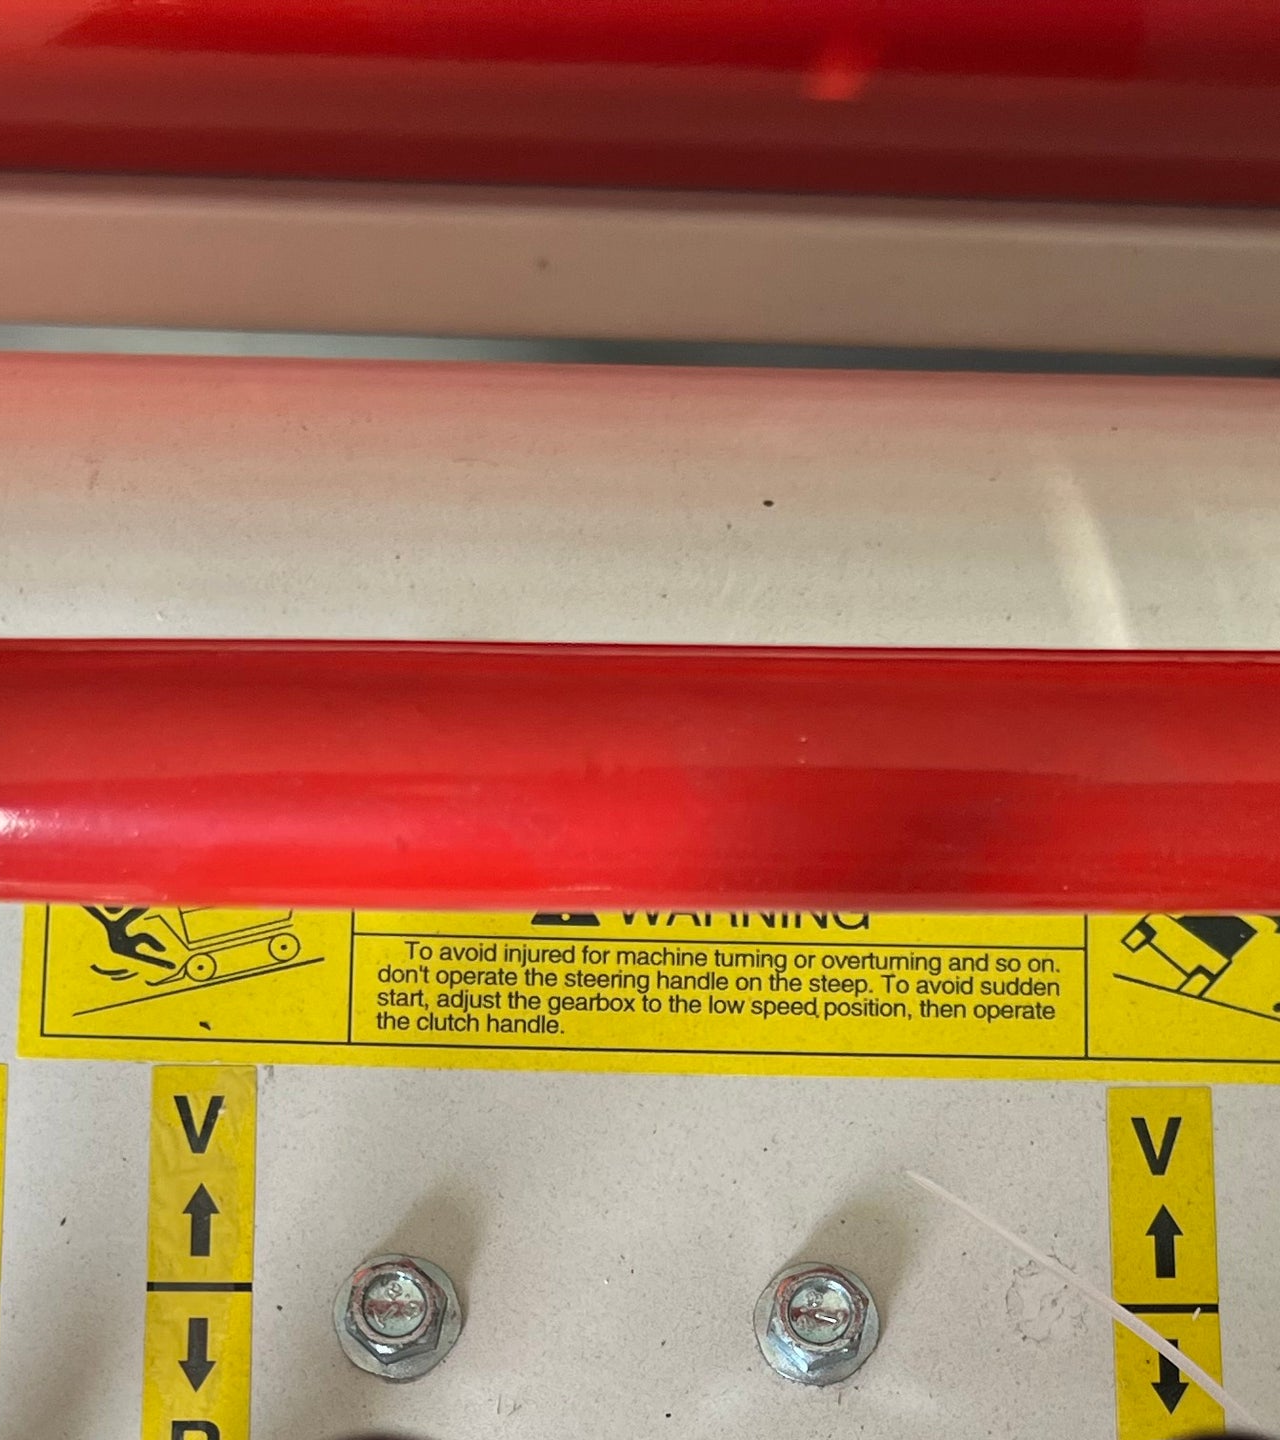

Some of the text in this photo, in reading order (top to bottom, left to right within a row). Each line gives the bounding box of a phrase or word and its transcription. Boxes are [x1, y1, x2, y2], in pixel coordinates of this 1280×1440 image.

[404, 940, 433, 961] To
[439, 943, 497, 962] avoid
[504, 943, 575, 967] injured
[582, 945, 610, 964] for
[616, 946, 708, 966] machine
[794, 953, 816, 969] or
[948, 953, 989, 972] and
[995, 958, 1021, 972] so
[1028, 958, 1060, 973] on.
[377, 964, 1060, 998] don't operate the steering handle on the steep. To avoid sudden
[376, 1012, 565, 1034] the clutch handle.
[377, 988, 1056, 1024] start, adjust the gearbox to the low speed position, then operate
[173, 1095, 224, 1154] V
[1131, 1116, 1182, 1176] V
